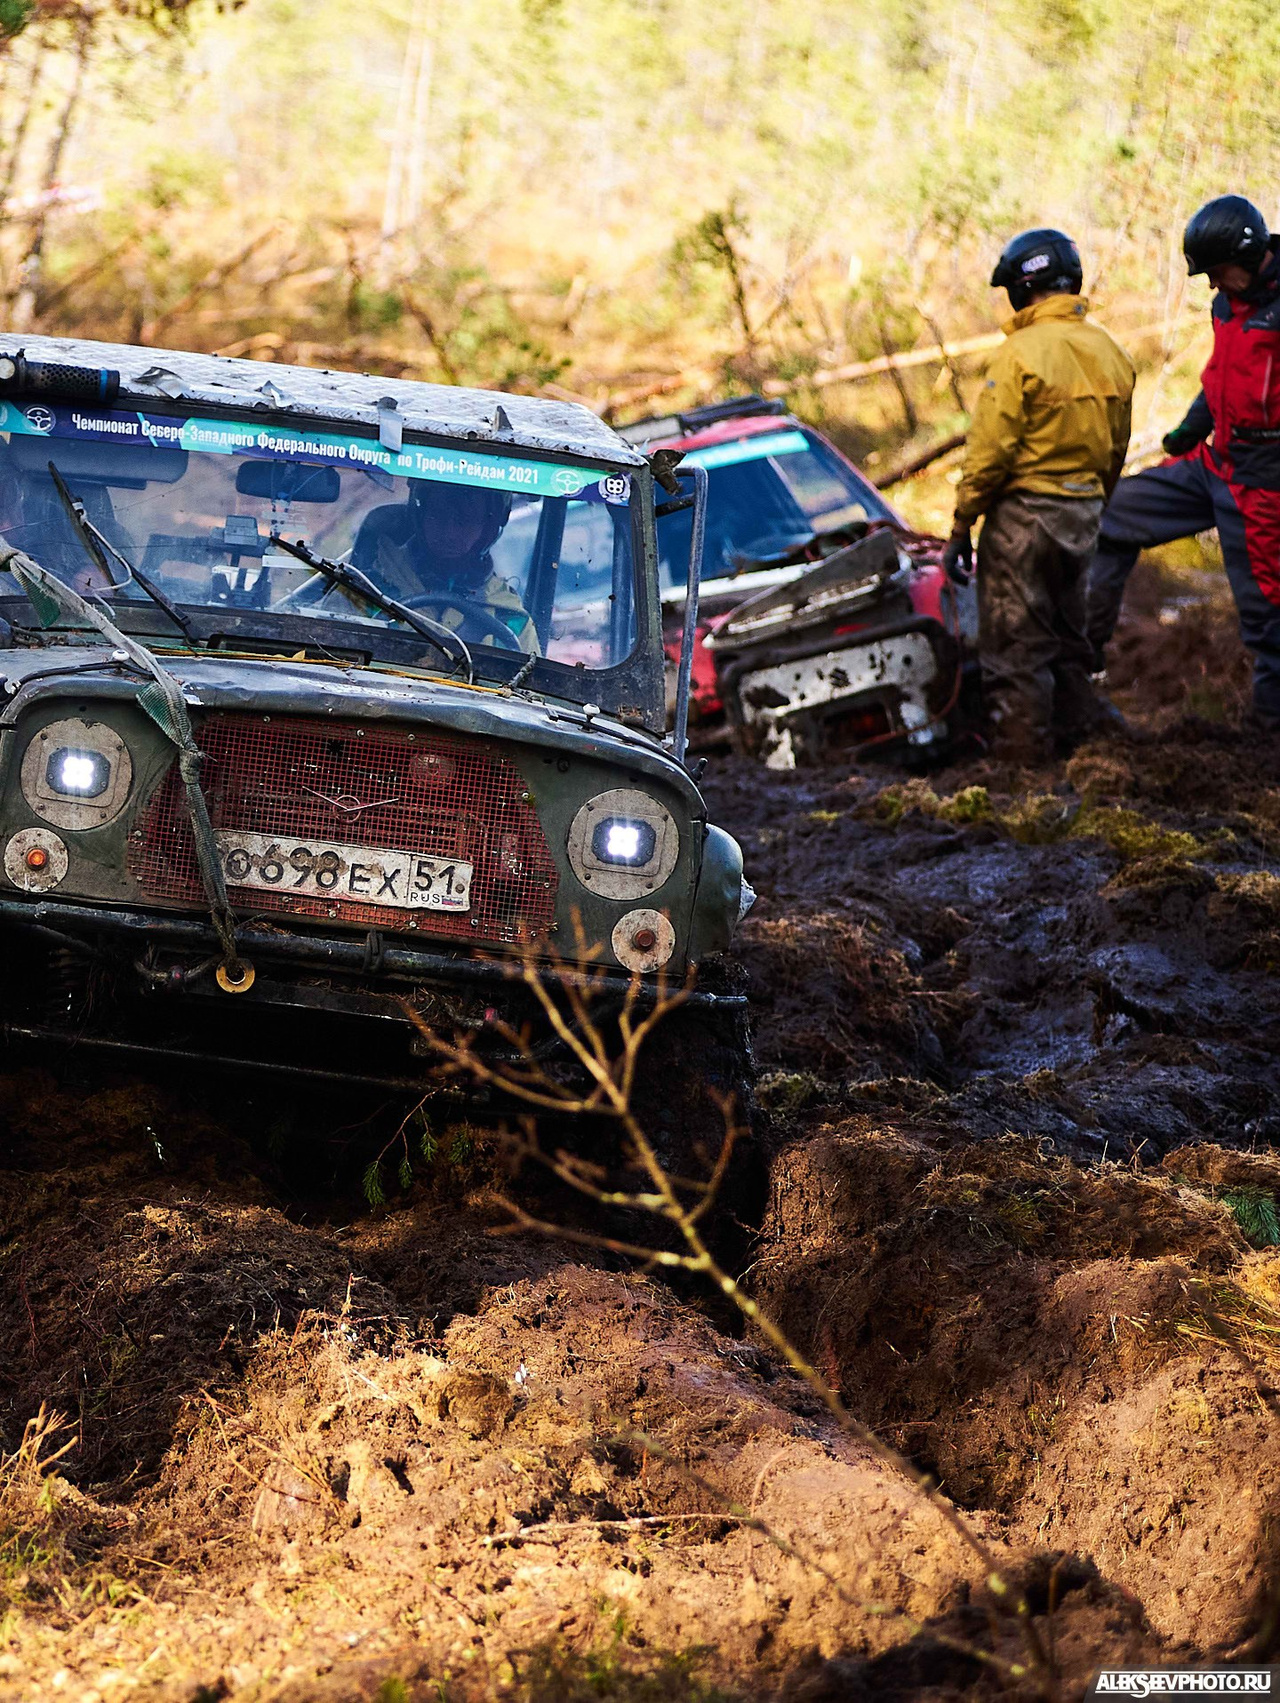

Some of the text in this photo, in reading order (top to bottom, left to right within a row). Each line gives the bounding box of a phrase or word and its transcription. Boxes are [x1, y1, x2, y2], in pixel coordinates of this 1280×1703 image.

[72, 413, 539, 484] Чемпионат Северо-Западного Федерального Округа по Трофи-Рейдам 2021
[414, 860, 456, 895] 51
[410, 891, 441, 904] RUS
